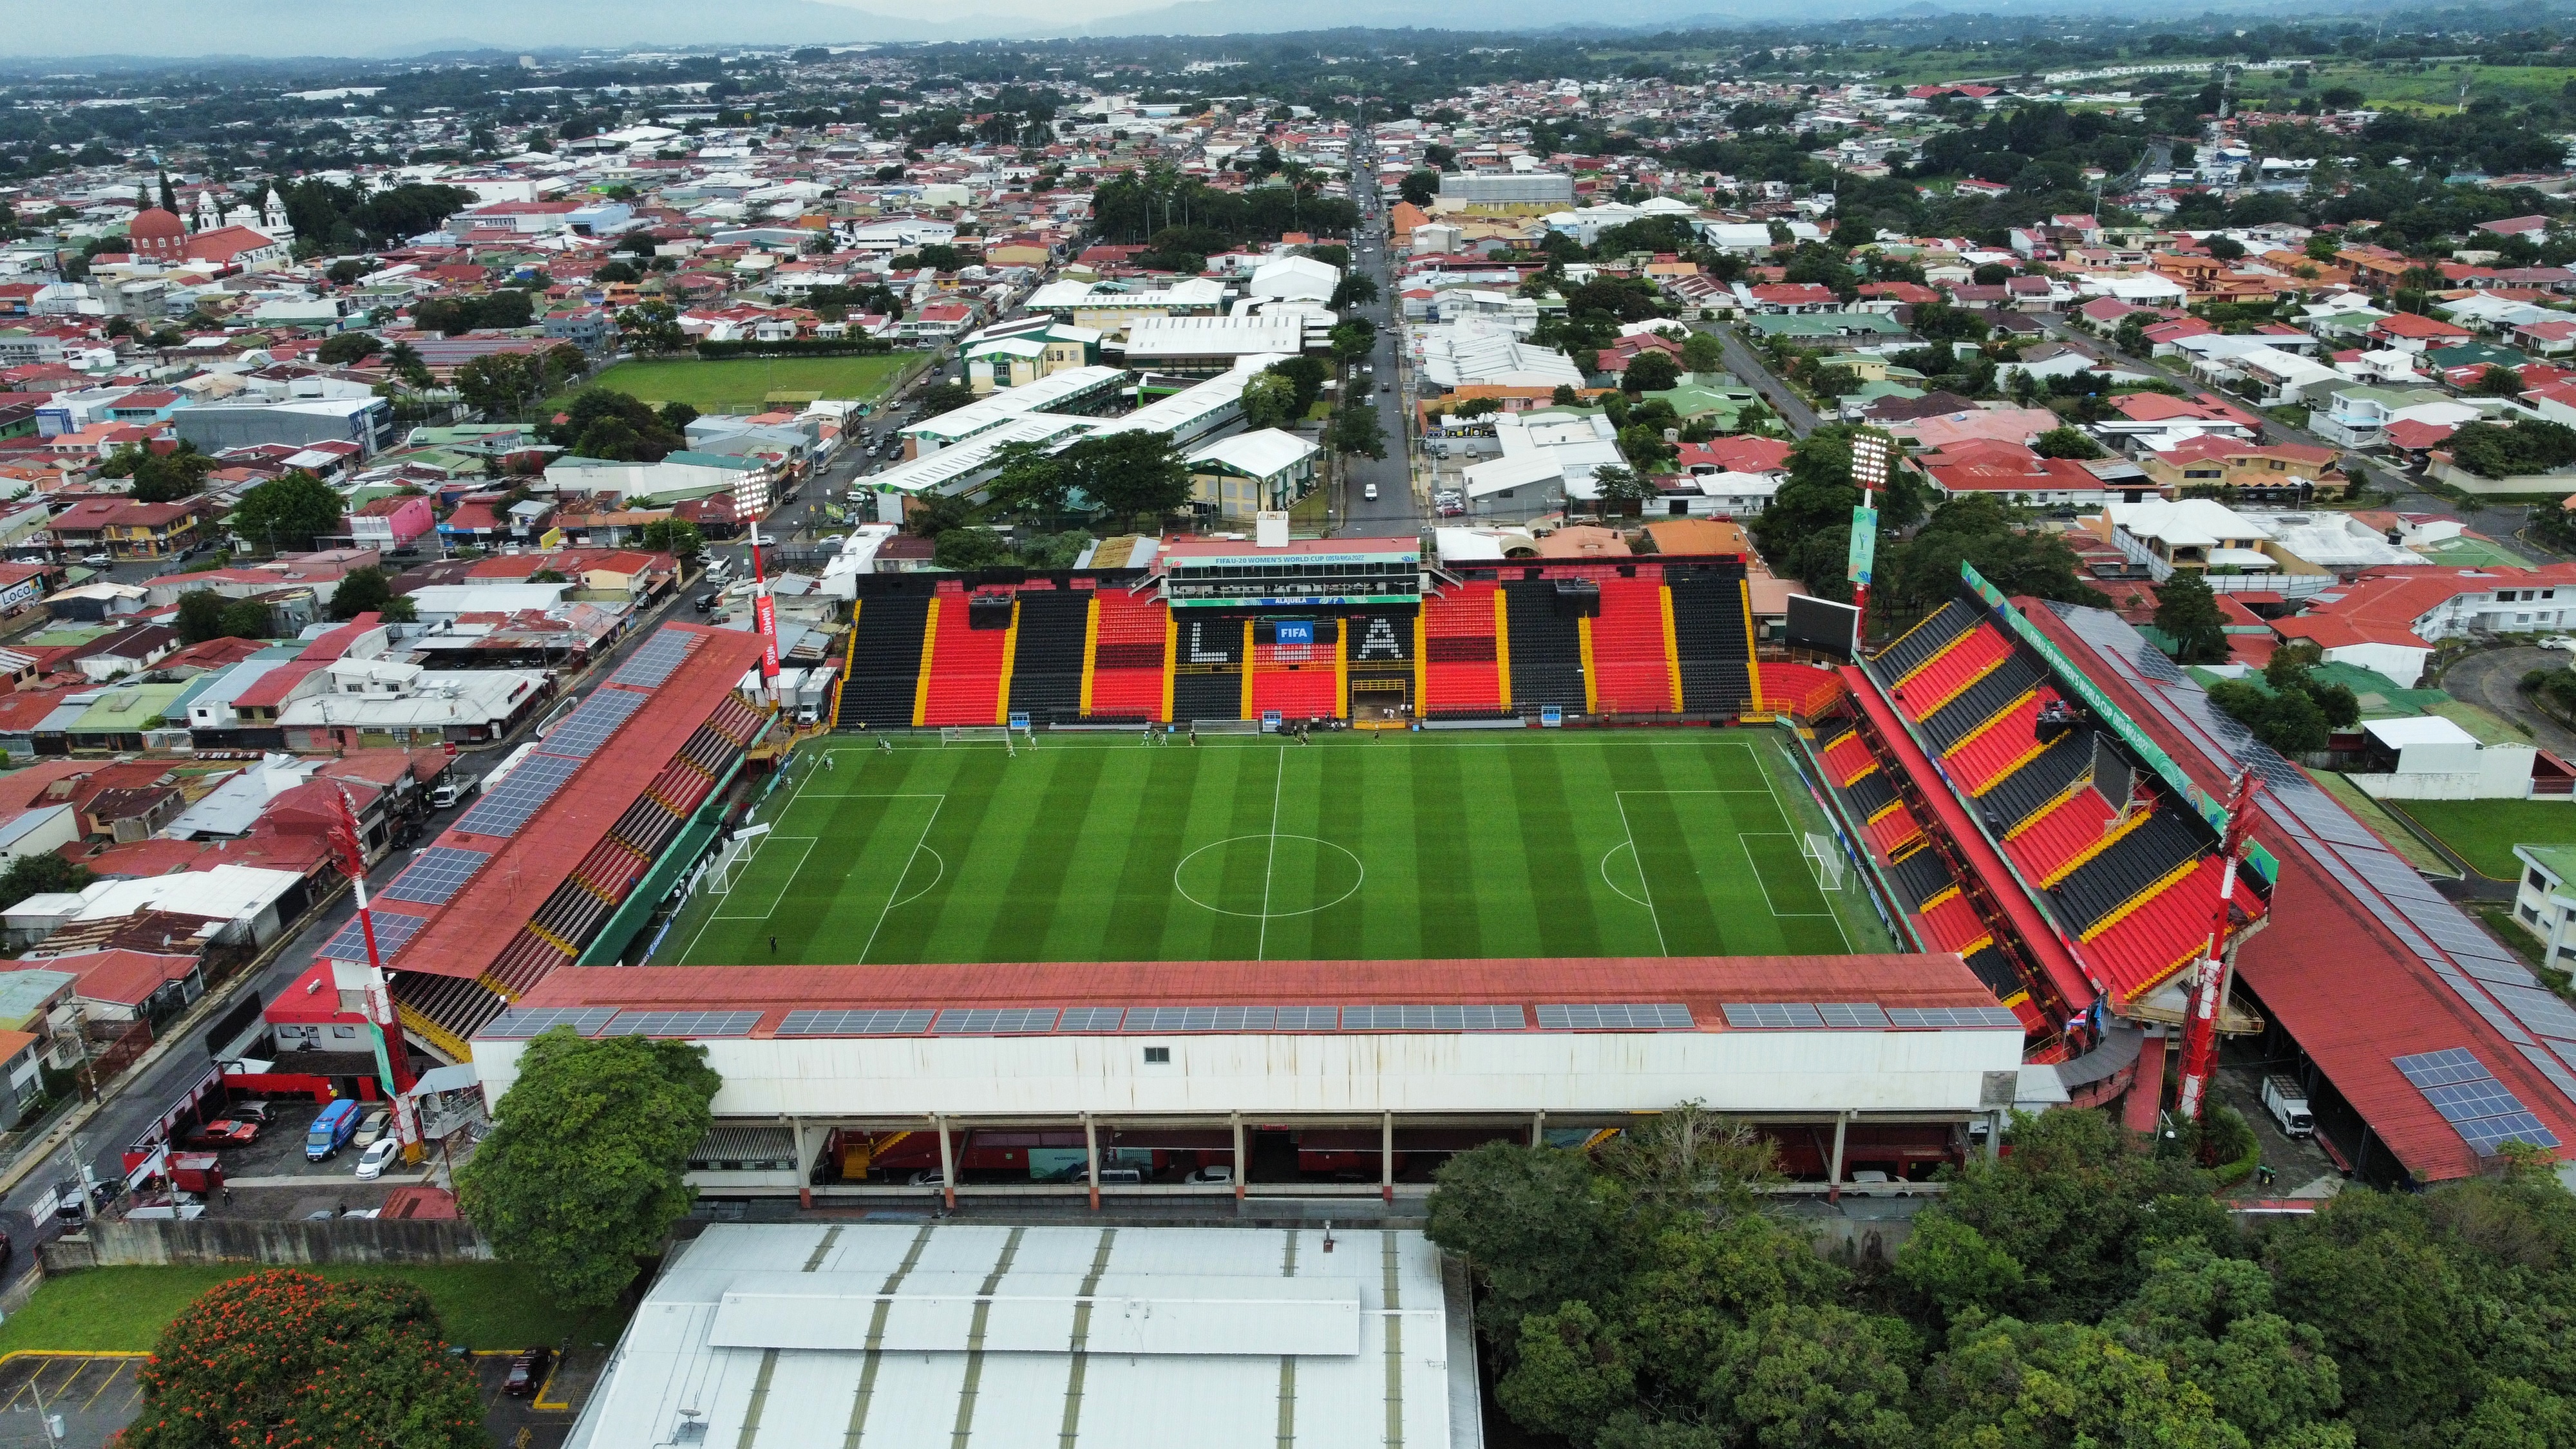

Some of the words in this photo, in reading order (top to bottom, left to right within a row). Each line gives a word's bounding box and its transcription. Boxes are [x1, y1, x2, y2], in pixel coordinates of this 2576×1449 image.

[2, 585, 31, 605] Loca
[761, 607, 773, 636] VAMOS
[1280, 628, 1307, 638] FIFA
[766, 644, 777, 666] NTAS
[2029, 630, 2041, 647] FIFA
[2040, 640, 2053, 661] U-20
[2052, 654, 2079, 687] WOMEN'S
[2079, 679, 2100, 707] WORLD
[2100, 699, 2112, 719] CUP
